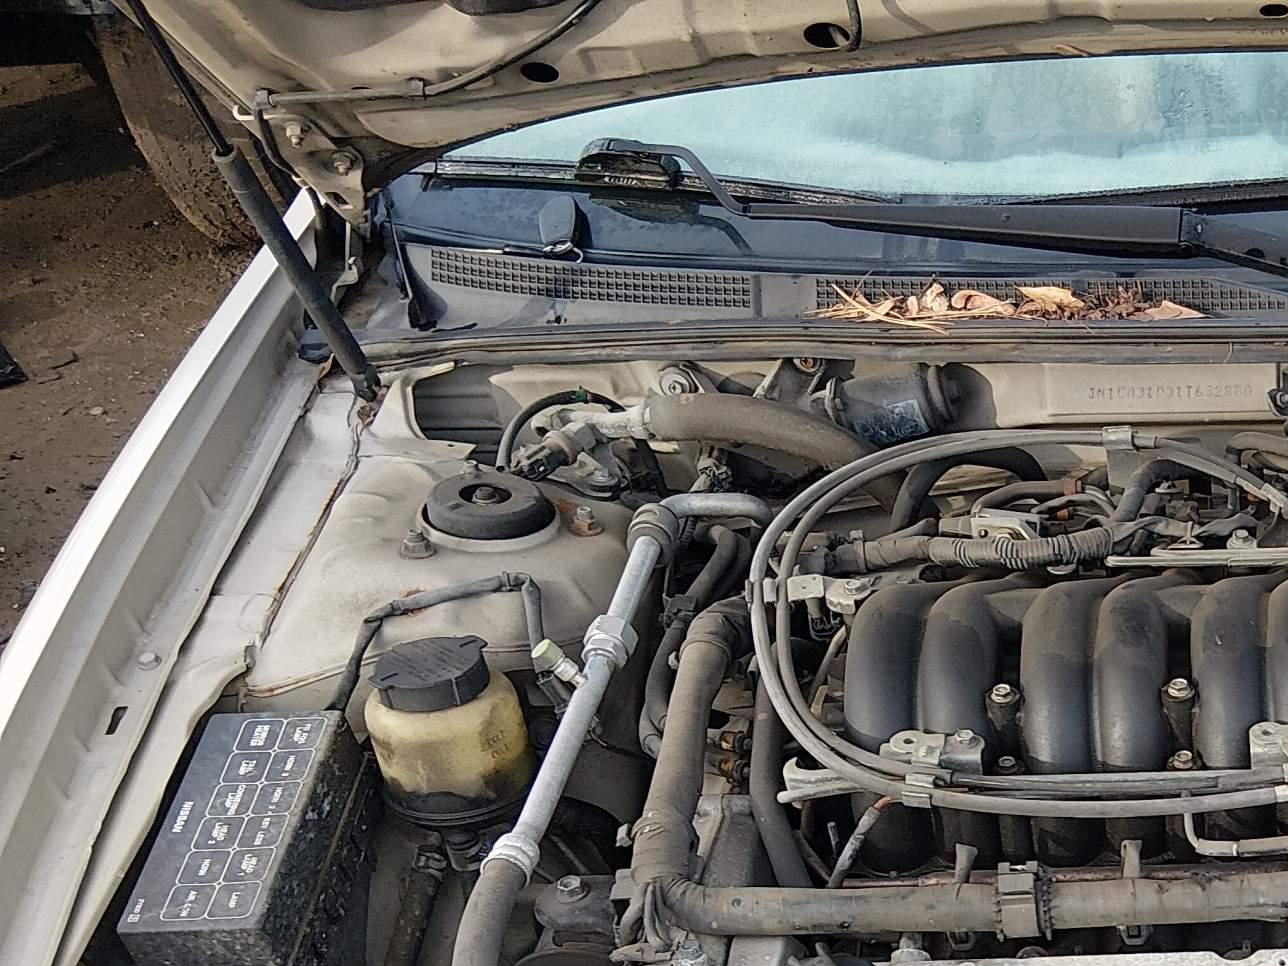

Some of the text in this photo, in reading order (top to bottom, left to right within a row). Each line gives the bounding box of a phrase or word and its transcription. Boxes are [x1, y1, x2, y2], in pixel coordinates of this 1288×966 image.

[284, 755, 296, 771] HORN
[171, 801, 194, 833] NISSAN
[197, 858, 212, 876] HORN
[228, 891, 241, 909] LAMP
